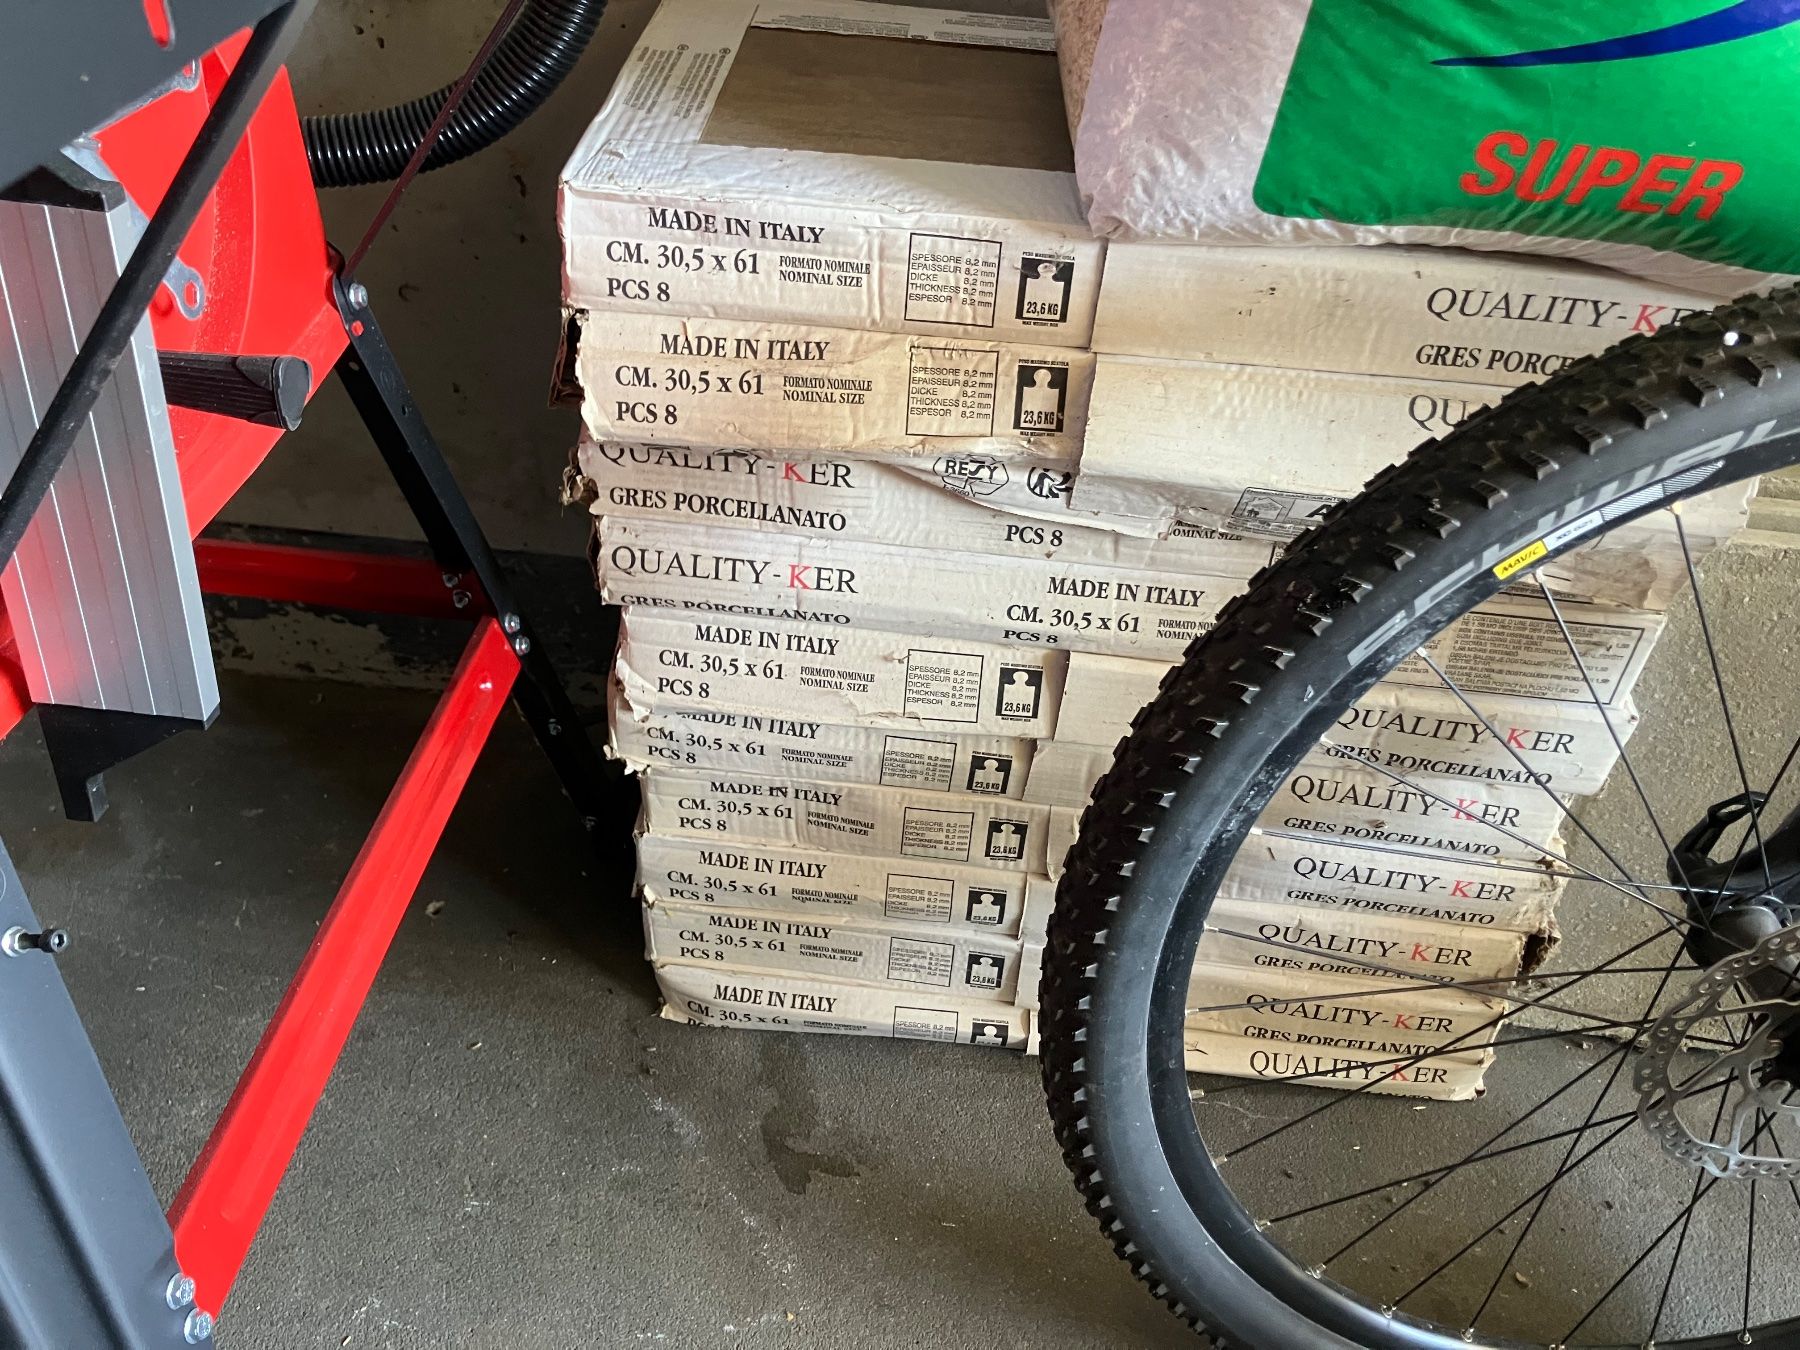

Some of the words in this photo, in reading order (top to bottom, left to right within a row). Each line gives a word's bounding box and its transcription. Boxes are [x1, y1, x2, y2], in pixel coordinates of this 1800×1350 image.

[1459, 131, 1744, 222] SUPER
[648, 206, 718, 234] MADE
[725, 217, 751, 238] IN
[759, 221, 825, 244] ITALY
[606, 240, 649, 265] CM.
[658, 245, 704, 272] 30,5
[712, 254, 727, 272] x
[734, 249, 760, 275] 61
[779, 255, 822, 271] FORMATO
[824, 259, 871, 275] NOMINALE
[911, 263, 962, 275] EPAISSEUR
[912, 253, 962, 265] SPESSORE
[981, 260, 996, 268] mm
[607, 278, 650, 300] PCS
[657, 281, 671, 302] 8
[779, 270, 833, 286] NOMINAL
[837, 274, 862, 288] SIZE
[910, 272, 938, 282] DICKE
[979, 280, 995, 288] mm
[910, 283, 961, 294] THICKNESS
[978, 290, 994, 298] mm
[909, 293, 953, 304] ESPESOR
[977, 300, 993, 308] mm
[1026, 301, 1046, 317] 23,6
[1047, 303, 1059, 316] KG
[1426, 287, 1713, 334] QUALITY-KE
[660, 334, 726, 358] MADE
[734, 338, 760, 360] IN
[767, 340, 830, 361] ITALY
[1416, 344, 1481, 368] GRES
[615, 366, 657, 388] CM.
[665, 368, 710, 395] 30,5
[717, 376, 732, 393] x
[739, 370, 764, 395] 61
[783, 375, 824, 390] FORMATO
[827, 378, 872, 392] NOMINALE
[783, 390, 836, 404] NOMINAL
[839, 393, 865, 405] SIZE
[616, 401, 657, 423] PCS
[664, 404, 677, 425] 8
[1023, 410, 1043, 426] 23,6
[1044, 411, 1055, 425] KG
[600, 444, 855, 488] QUALITY-KER
[609, 486, 666, 508] GRES
[673, 492, 846, 532] PORCELLANATO
[1004, 524, 1044, 545] PCS
[1050, 530, 1063, 546] 8
[1168, 527, 1216, 540] OMINAL
[611, 546, 858, 594] QUALITY-KER
[1501, 546, 1540, 575] MAVIC
[1047, 576, 1109, 600] MADE
[1116, 582, 1140, 602] IN
[1146, 586, 1205, 607] ITALY
[620, 595, 676, 608] GRES
[685, 600, 851, 625] PORCELLANATO
[1006, 604, 1043, 624] CM.
[1050, 608, 1091, 631] 30,5
[1096, 616, 1112, 631] x
[1117, 613, 1140, 633] 61
[1002, 629, 1040, 641] PCS
[1046, 634, 1058, 643] 8
[1158, 618, 1196, 630] FORMATO
[695, 624, 752, 646] MADE
[758, 631, 780, 650] IN
[786, 634, 840, 656] ITALY
[658, 650, 694, 669] CM.
[700, 654, 739, 676] 30,5
[745, 663, 758, 677] x
[763, 660, 784, 680] 61
[800, 666, 836, 679] FORMATO
[836, 670, 875, 683] NOMINALE
[658, 677, 693, 697] PCS
[698, 682, 710, 698] 8
[799, 678, 844, 691] NOMINAL
[847, 681, 869, 693] SIZE
[1004, 702, 1021, 714] 23,6
[1021, 703, 1031, 713] KG
[741, 716, 763, 731] IN
[768, 719, 820, 740] ITALY
[647, 727, 680, 743] CM.
[686, 733, 723, 751] 30,5
[745, 741, 766, 756] 61
[648, 745, 681, 761] PCS
[686, 751, 697, 764] 8
[781, 754, 824, 765] NOMINAL
[826, 759, 847, 768] SIZE
[782, 747, 815, 759] FORMATO
[817, 751, 853, 762] NOMINALE
[1384, 752, 1553, 786] PORCELLANATO
[710, 781, 762, 796] MADE
[768, 786, 788, 798] IN
[794, 788, 842, 806] ITALY
[1291, 775, 1520, 828] QUALITY-KER
[678, 798, 711, 811] CM.
[717, 801, 752, 816] 30,5
[774, 804, 793, 819] 61
[679, 816, 711, 830] PCS
[717, 819, 727, 831] 8
[1284, 816, 1337, 834] GRES
[1344, 826, 1501, 857] PORCELLANATO
[699, 850, 749, 870] MADE
[754, 858, 773, 875] IN
[779, 861, 827, 879] ITALY
[667, 870, 698, 885] CM.
[703, 876, 737, 892] 30,5
[758, 882, 777, 897] 61
[1293, 856, 1515, 902] QUALITY-KER
[669, 888, 699, 900] PCS
[704, 893, 714, 902] 8
[1287, 889, 1338, 904] GRES
[1344, 897, 1494, 925] PORCELLANATO
[709, 915, 757, 930] MADE
[763, 921, 781, 934] IN
[787, 923, 832, 939] ITALY
[679, 930, 709, 943] CM.
[715, 933, 747, 948] 30,5
[768, 938, 786, 952] 61
[1258, 923, 1472, 966] QUALITY-KER
[680, 946, 710, 959] PCS
[715, 950, 724, 961] 8
[1254, 954, 1302, 969] GRES
[1307, 962, 1455, 984] PORCELLATO
[714, 984, 763, 1004] MADE
[768, 991, 786, 1007] IN
[791, 993, 837, 1012] ITALY
[687, 1001, 714, 1018] CM.
[719, 1010, 751, 1023] 30,5
[772, 1016, 789, 1025] 61
[1246, 994, 1453, 1032] QUALITY-KER
[1243, 1025, 1291, 1041] GRES
[1250, 1050, 1448, 1083] QUALITY-KER
